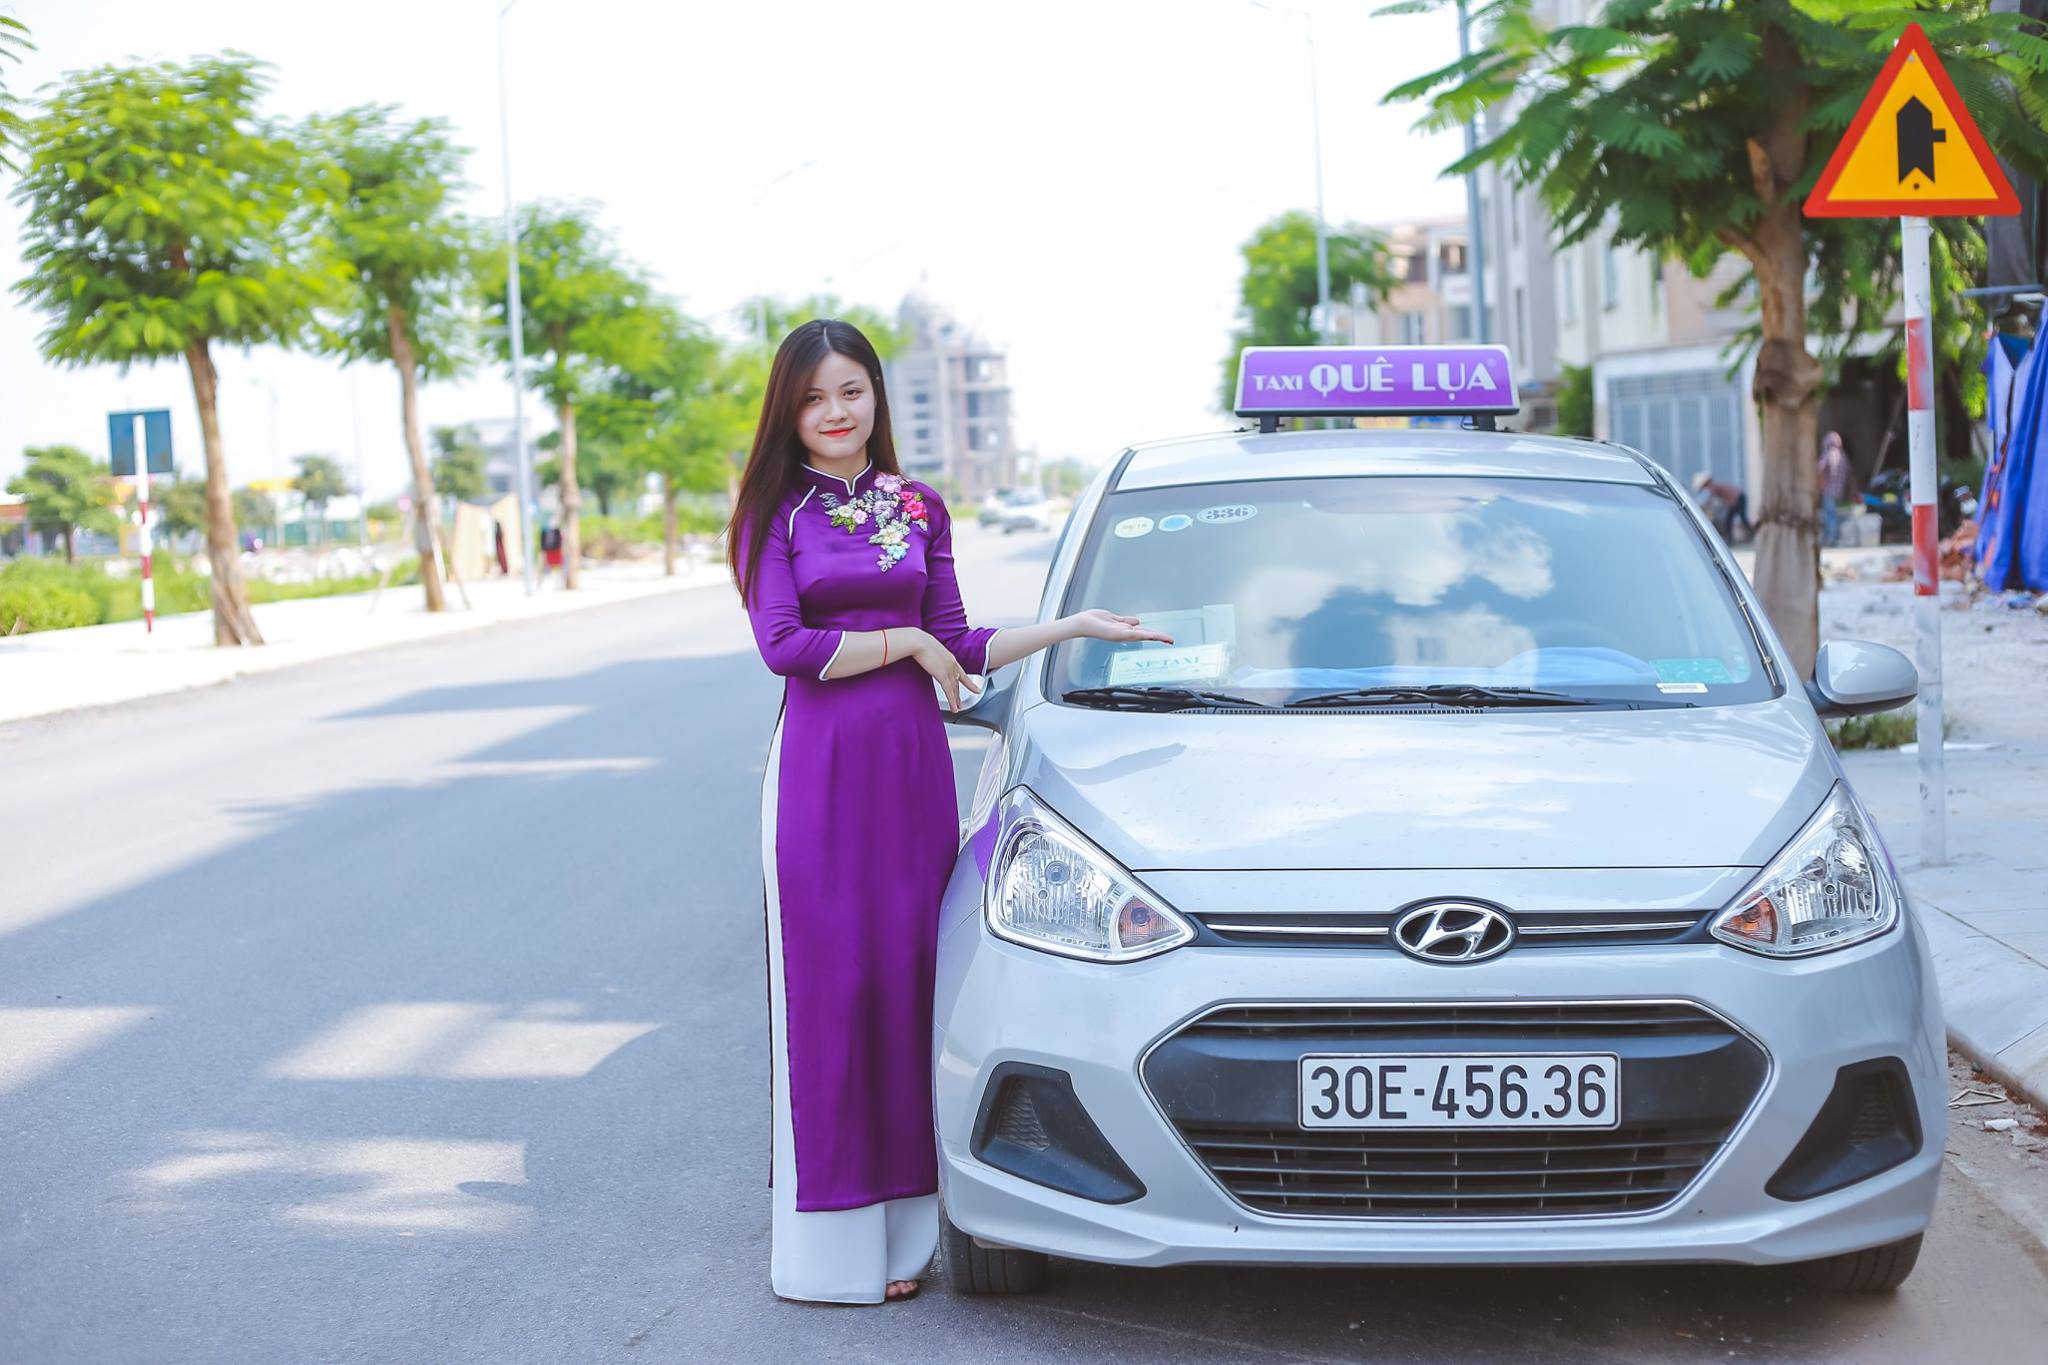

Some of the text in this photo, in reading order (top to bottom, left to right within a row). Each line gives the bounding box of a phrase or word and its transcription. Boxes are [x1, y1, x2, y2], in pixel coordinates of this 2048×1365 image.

[1252, 355, 1497, 400] TAXI QUÊ LỤA
[1310, 1064, 1607, 1120] 30E-456.36
